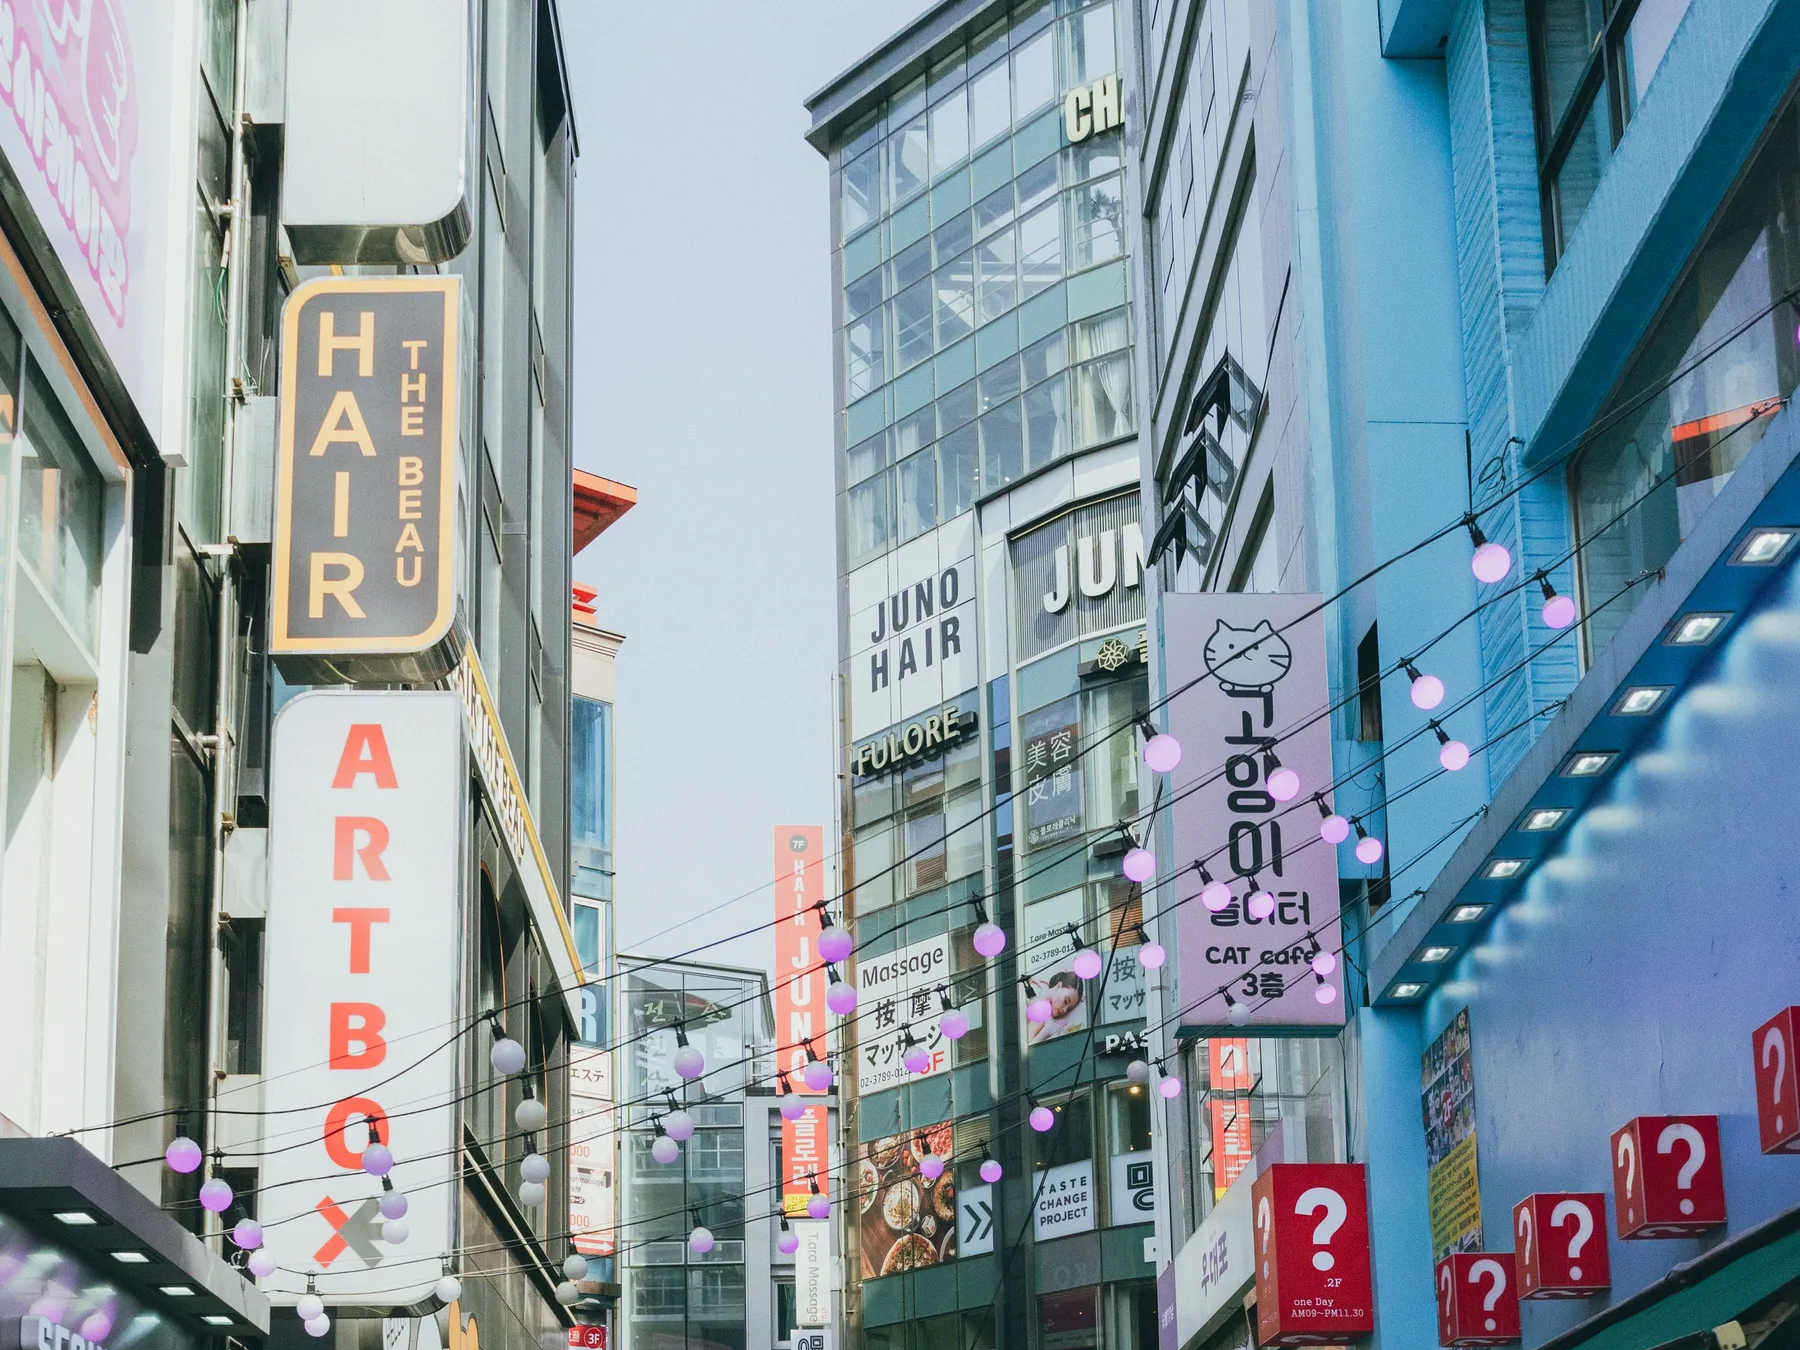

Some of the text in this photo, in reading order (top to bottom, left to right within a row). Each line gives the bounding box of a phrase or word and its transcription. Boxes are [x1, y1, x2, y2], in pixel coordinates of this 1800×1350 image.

[309, 312, 376, 619] HAIR
[395, 340, 427, 587] THE BEAU
[871, 567, 959, 643] JUNO
[871, 615, 961, 693] HAIR
[858, 706, 960, 777] FULORE
[1026, 730, 1072, 773] 美容
[792, 840, 805, 848] 7F
[794, 860, 805, 926] HAIR
[862, 947, 943, 989] Massage
[1205, 946, 1316, 966] CAT cafe
[312, 724, 399, 1268] ARTBOX
[1242, 971, 1285, 998] 3층
[790, 937, 812, 1082] JUNO
[875, 987, 932, 1030] 按摩
[1040, 1176, 1088, 1197] TASTE
[1040, 1191, 1088, 1211] CHANGE
[1040, 1206, 1088, 1227] PROJECT
[806, 1267, 819, 1323] Massage
[1294, 1297, 1334, 1307] one Day
[588, 1333, 600, 1345] 3F
